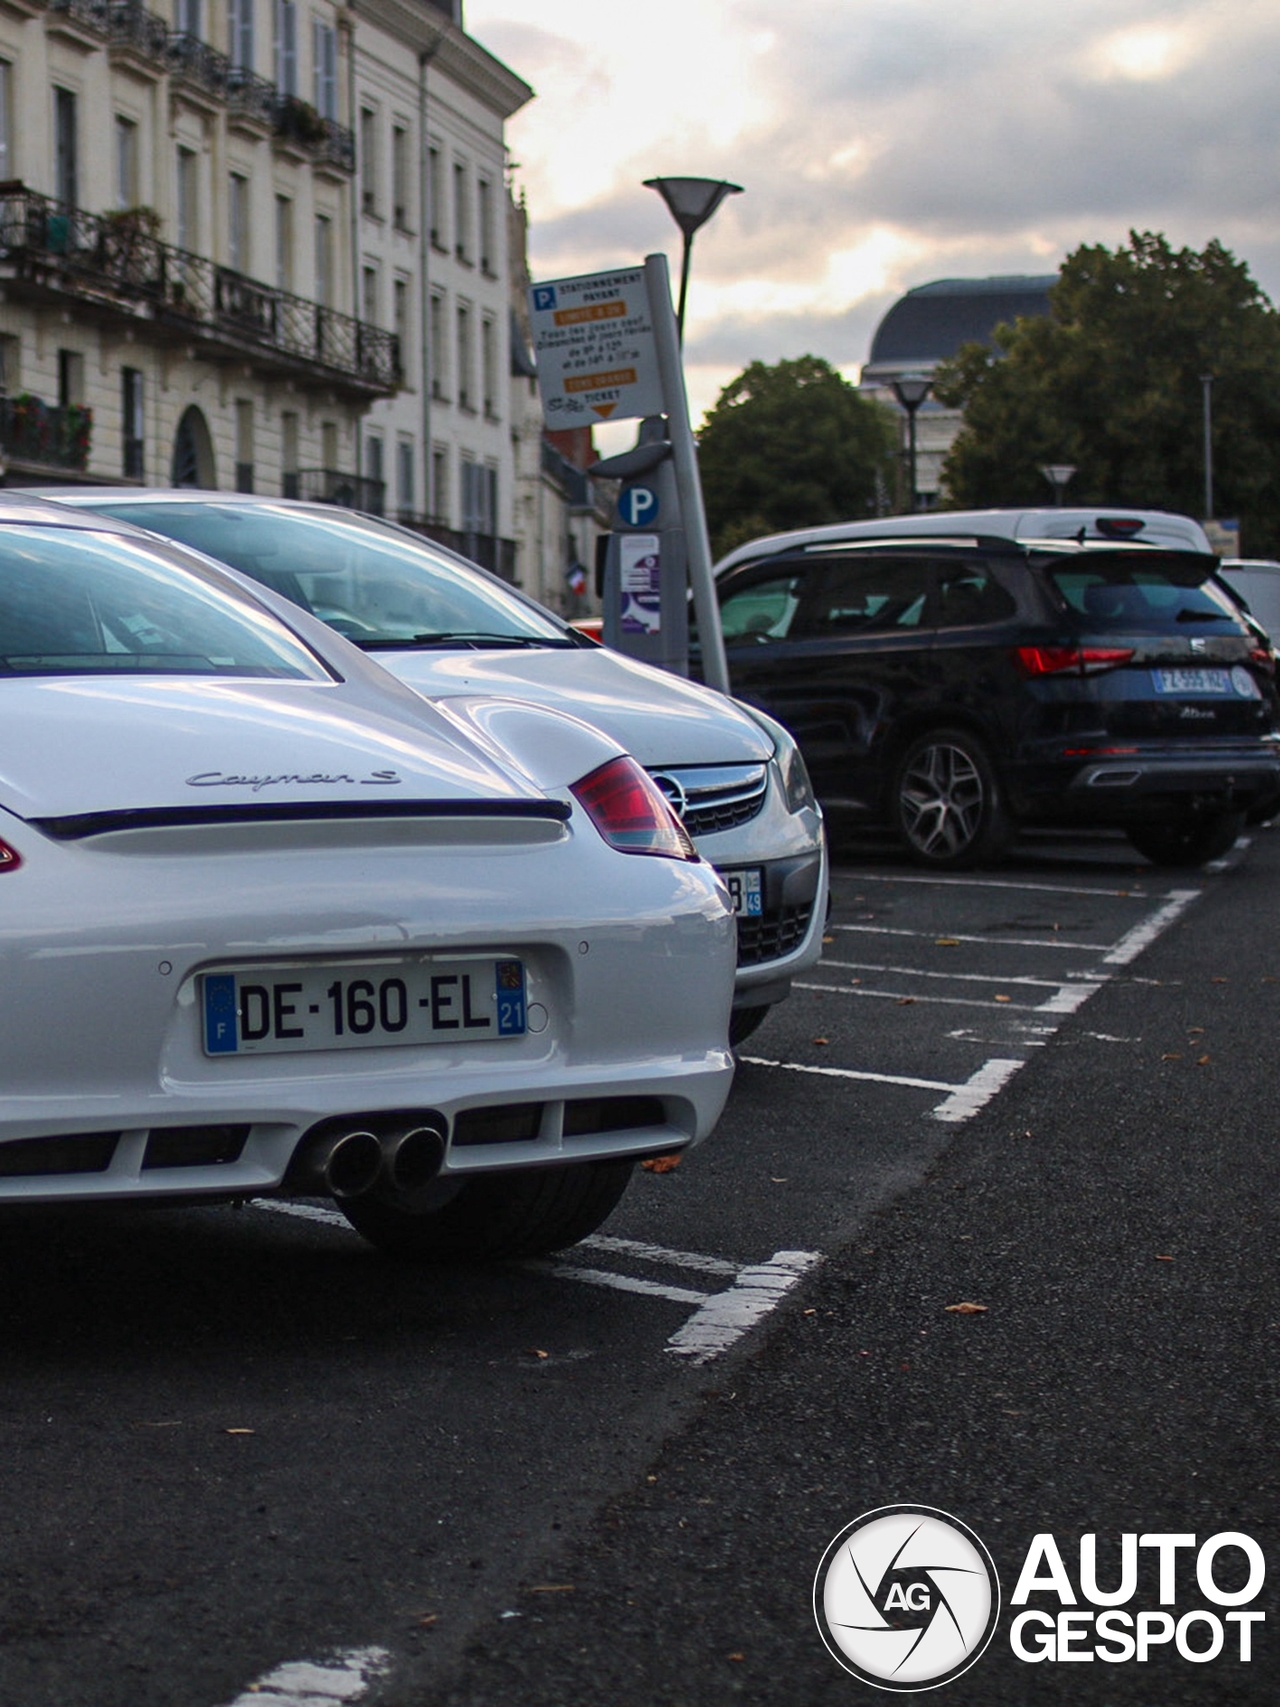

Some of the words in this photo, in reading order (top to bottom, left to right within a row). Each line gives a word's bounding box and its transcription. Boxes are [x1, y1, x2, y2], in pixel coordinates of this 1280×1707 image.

[559, 274, 640, 293] STATIONNEMENT
[583, 288, 619, 301] PAYANT
[585, 389, 620, 403] TICKET
[631, 488, 653, 525] P
[184, 771, 355, 793] Cayman
[360, 770, 402, 785] S
[216, 1021, 227, 1040] F
[240, 974, 491, 1041] DE-160-EL
[500, 1002, 524, 1029] 21
